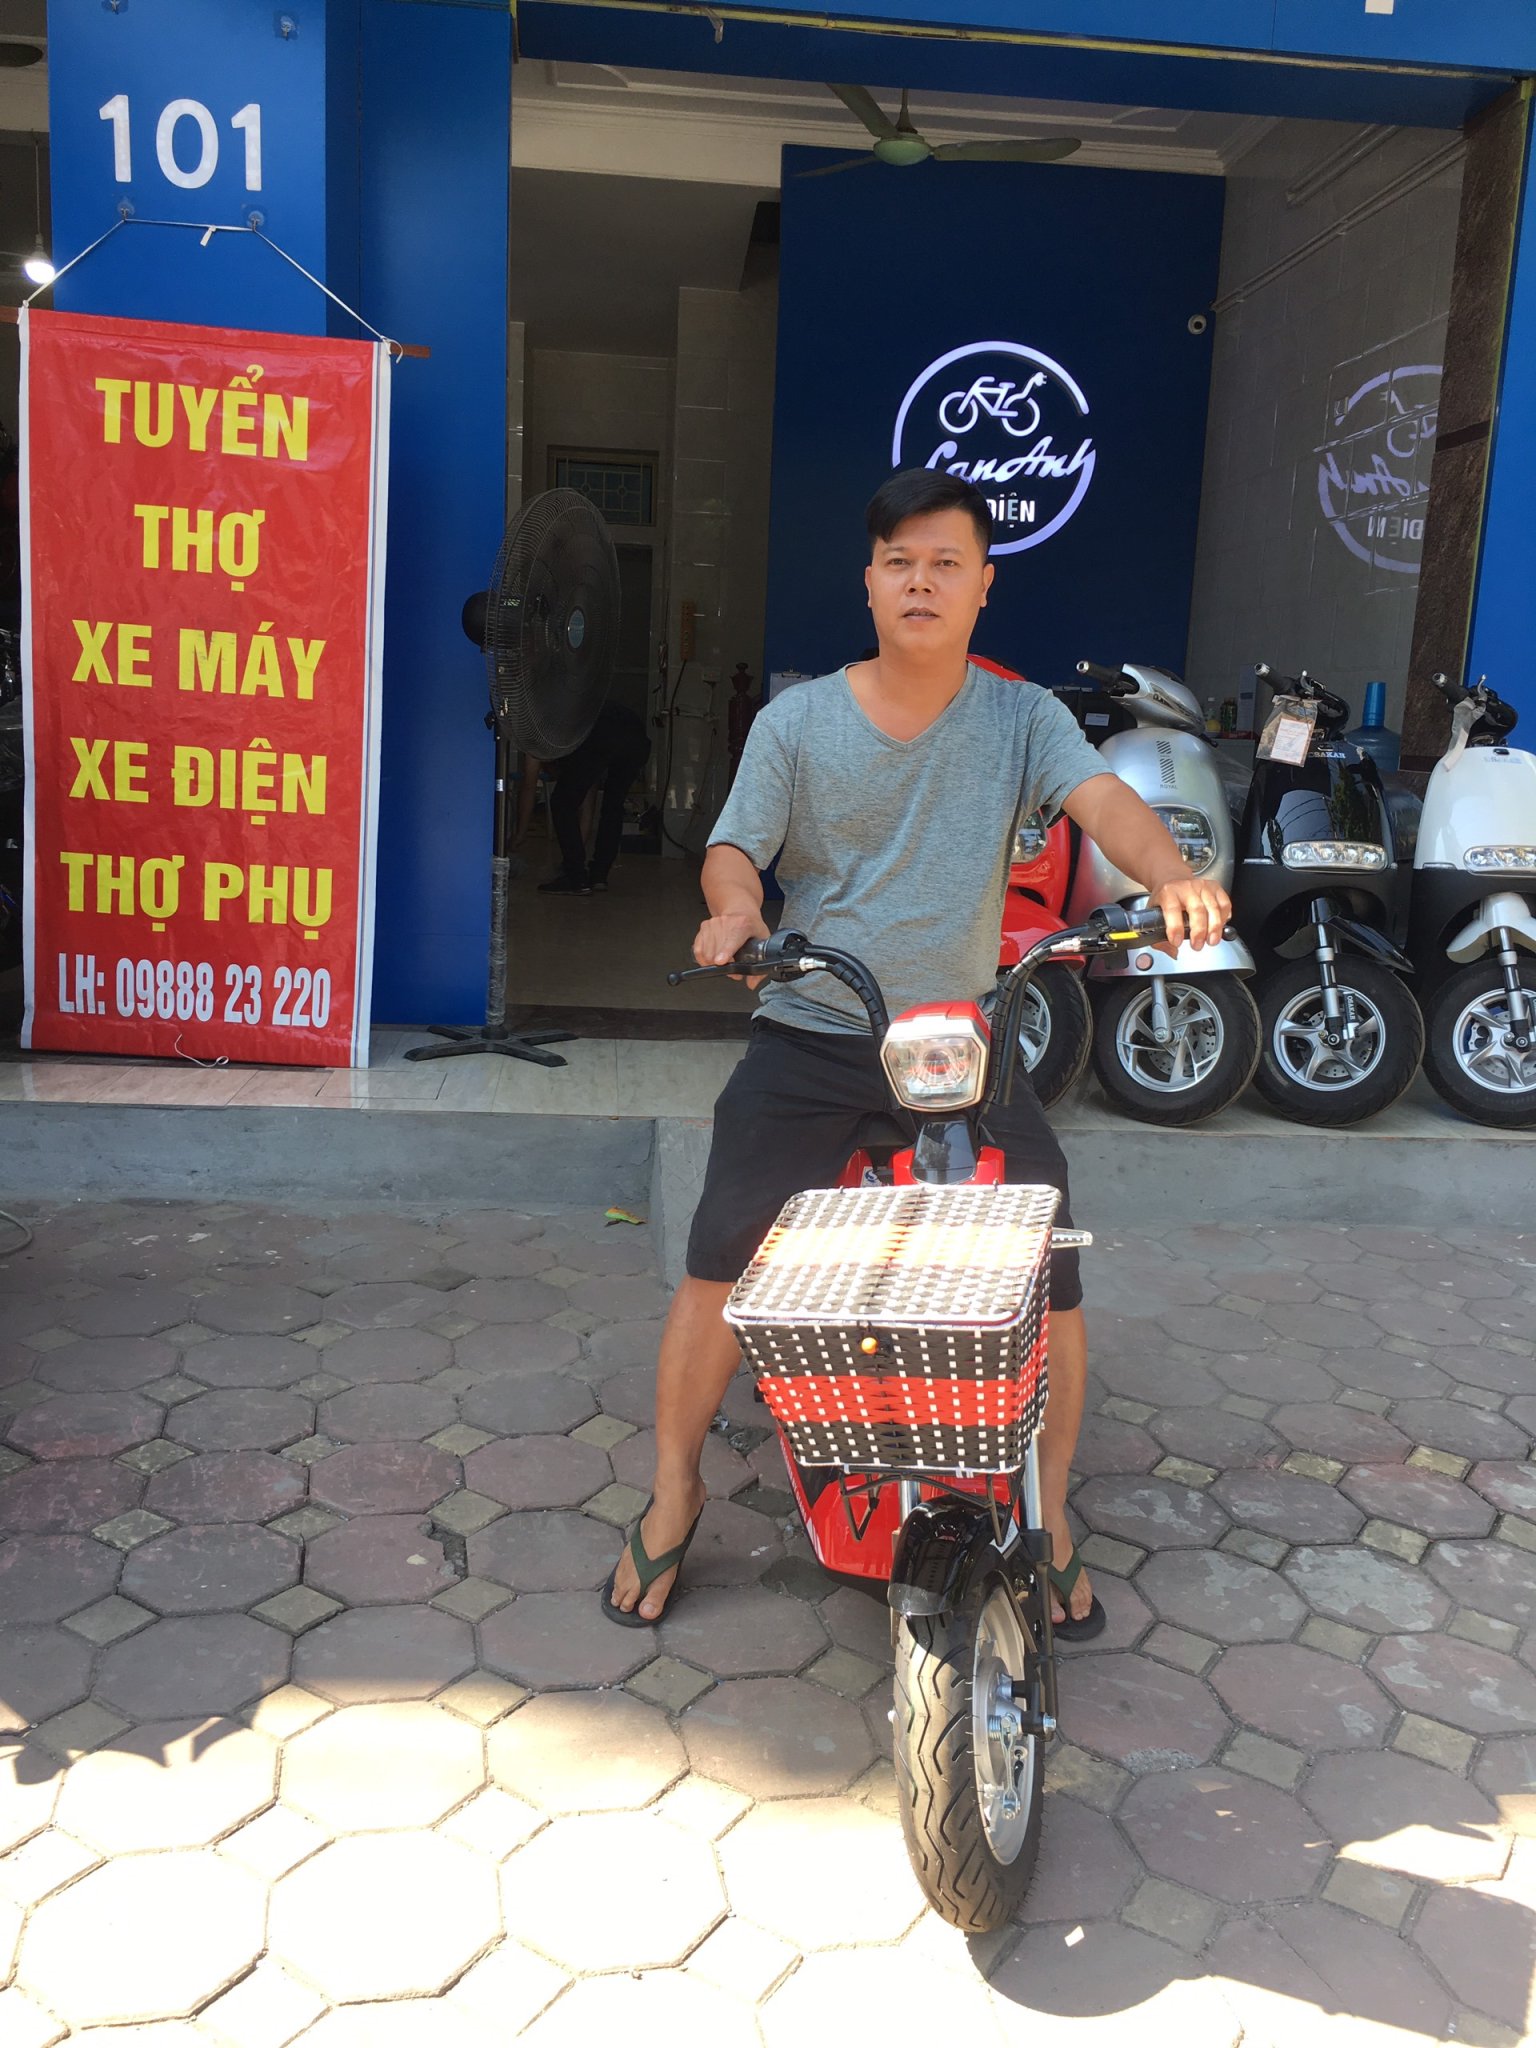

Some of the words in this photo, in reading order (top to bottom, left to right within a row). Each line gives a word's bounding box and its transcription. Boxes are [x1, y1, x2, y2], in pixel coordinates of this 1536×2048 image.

[99, 94, 262, 191] 101
[95, 364, 309, 460] TUYỂN
[134, 504, 266, 592] THỢ
[71, 619, 153, 687] XE
[178, 621, 327, 700] MÁY
[68, 737, 149, 803] XE
[171, 737, 327, 826] ĐIỆN
[60, 851, 185, 932] THỢ
[203, 862, 333, 940] PHỤ
[58, 952, 106, 1015] LH:
[116, 957, 214, 1022] 09888
[224, 963, 262, 1025] 23
[272, 966, 331, 1028] 220
